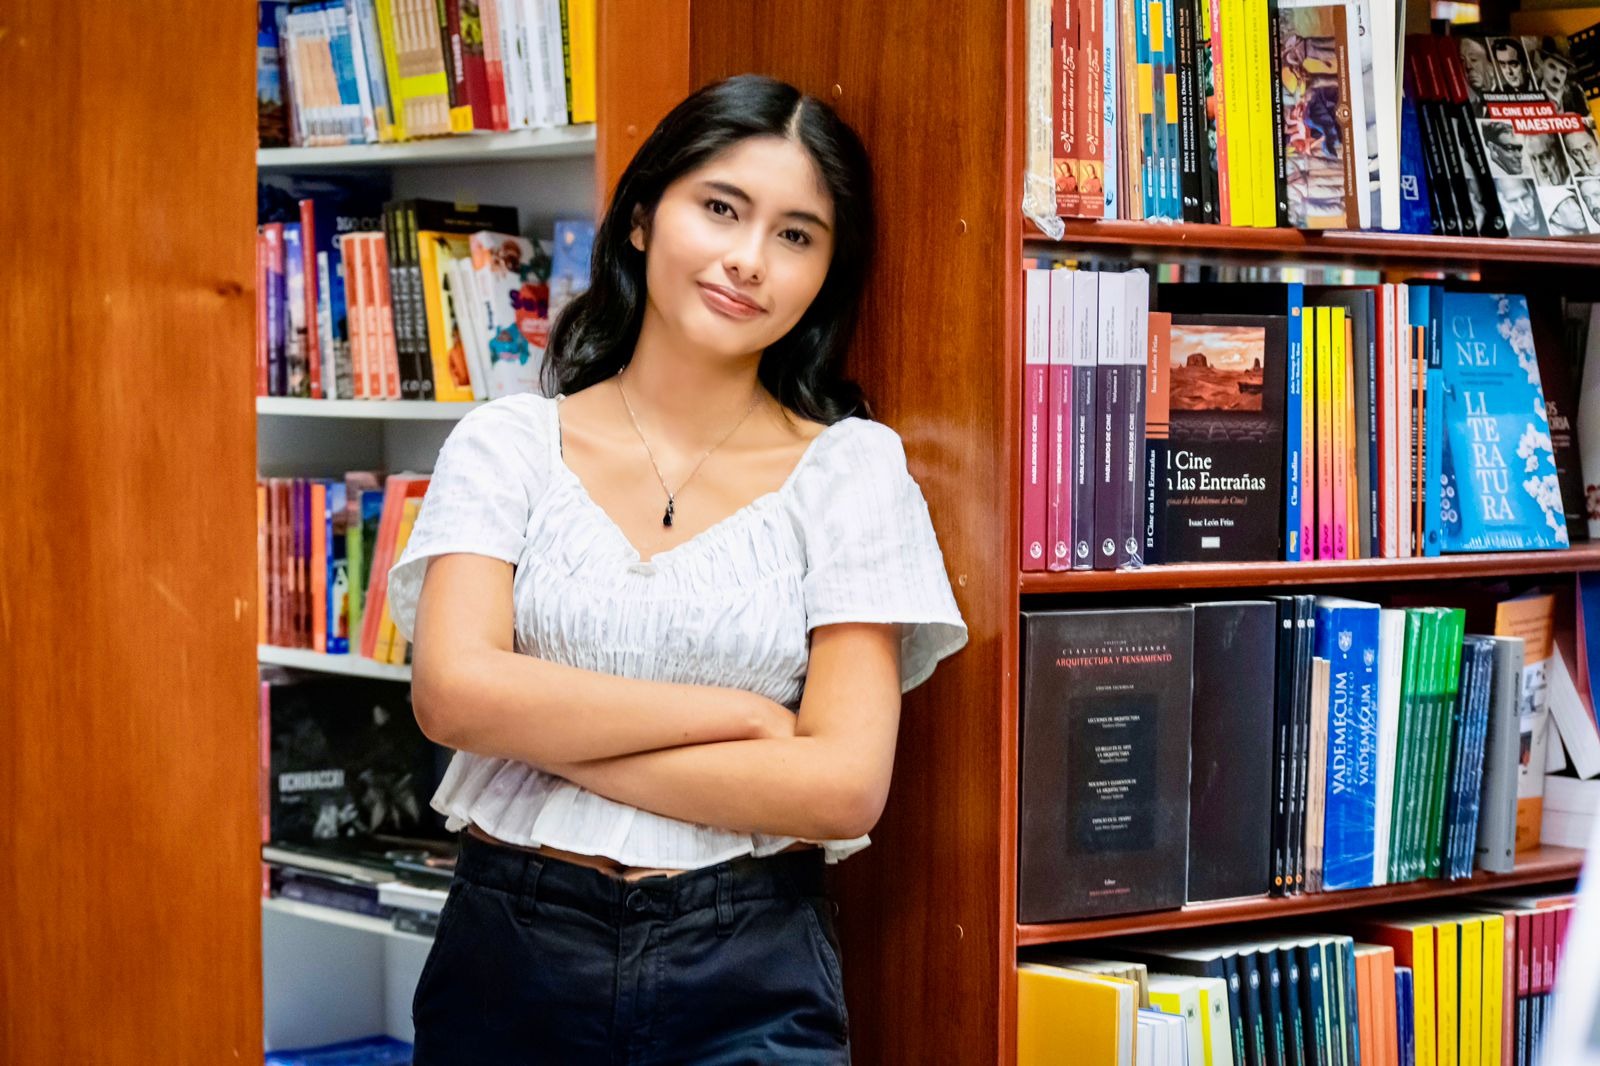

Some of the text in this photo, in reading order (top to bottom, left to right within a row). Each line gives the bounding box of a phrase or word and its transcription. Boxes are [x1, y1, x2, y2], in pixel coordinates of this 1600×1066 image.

[1483, 93, 1508, 101] FEDERICO
[1104, 107, 1114, 126] Los
[1491, 106, 1553, 116] EL CINE DE LOS
[1515, 116, 1580, 131] MAESTROS
[1452, 316, 1475, 339] CI
[1464, 391, 1487, 416] LI
[1106, 432, 1111, 442] DE
[1129, 431, 1135, 441] DE
[1467, 417, 1500, 442] TE
[1032, 432, 1038, 443] DE
[1057, 432, 1062, 443] DE
[1080, 434, 1085, 443] DE
[1175, 450, 1212, 470] Cine
[1472, 443, 1506, 468] RA
[1148, 449, 1156, 487] Entrañas
[1177, 470, 1196, 490] las
[1199, 472, 1266, 491] Entrañas
[1476, 469, 1509, 494] TU
[1149, 502, 1155, 513] en
[1481, 495, 1515, 520] RA
[1189, 518, 1204, 527] Isaac
[1204, 518, 1219, 527] León
[1147, 537, 1154, 548] El
[1056, 656, 1113, 669] ARQUITECTURA
[1122, 653, 1172, 663] PENSAMIENTO
